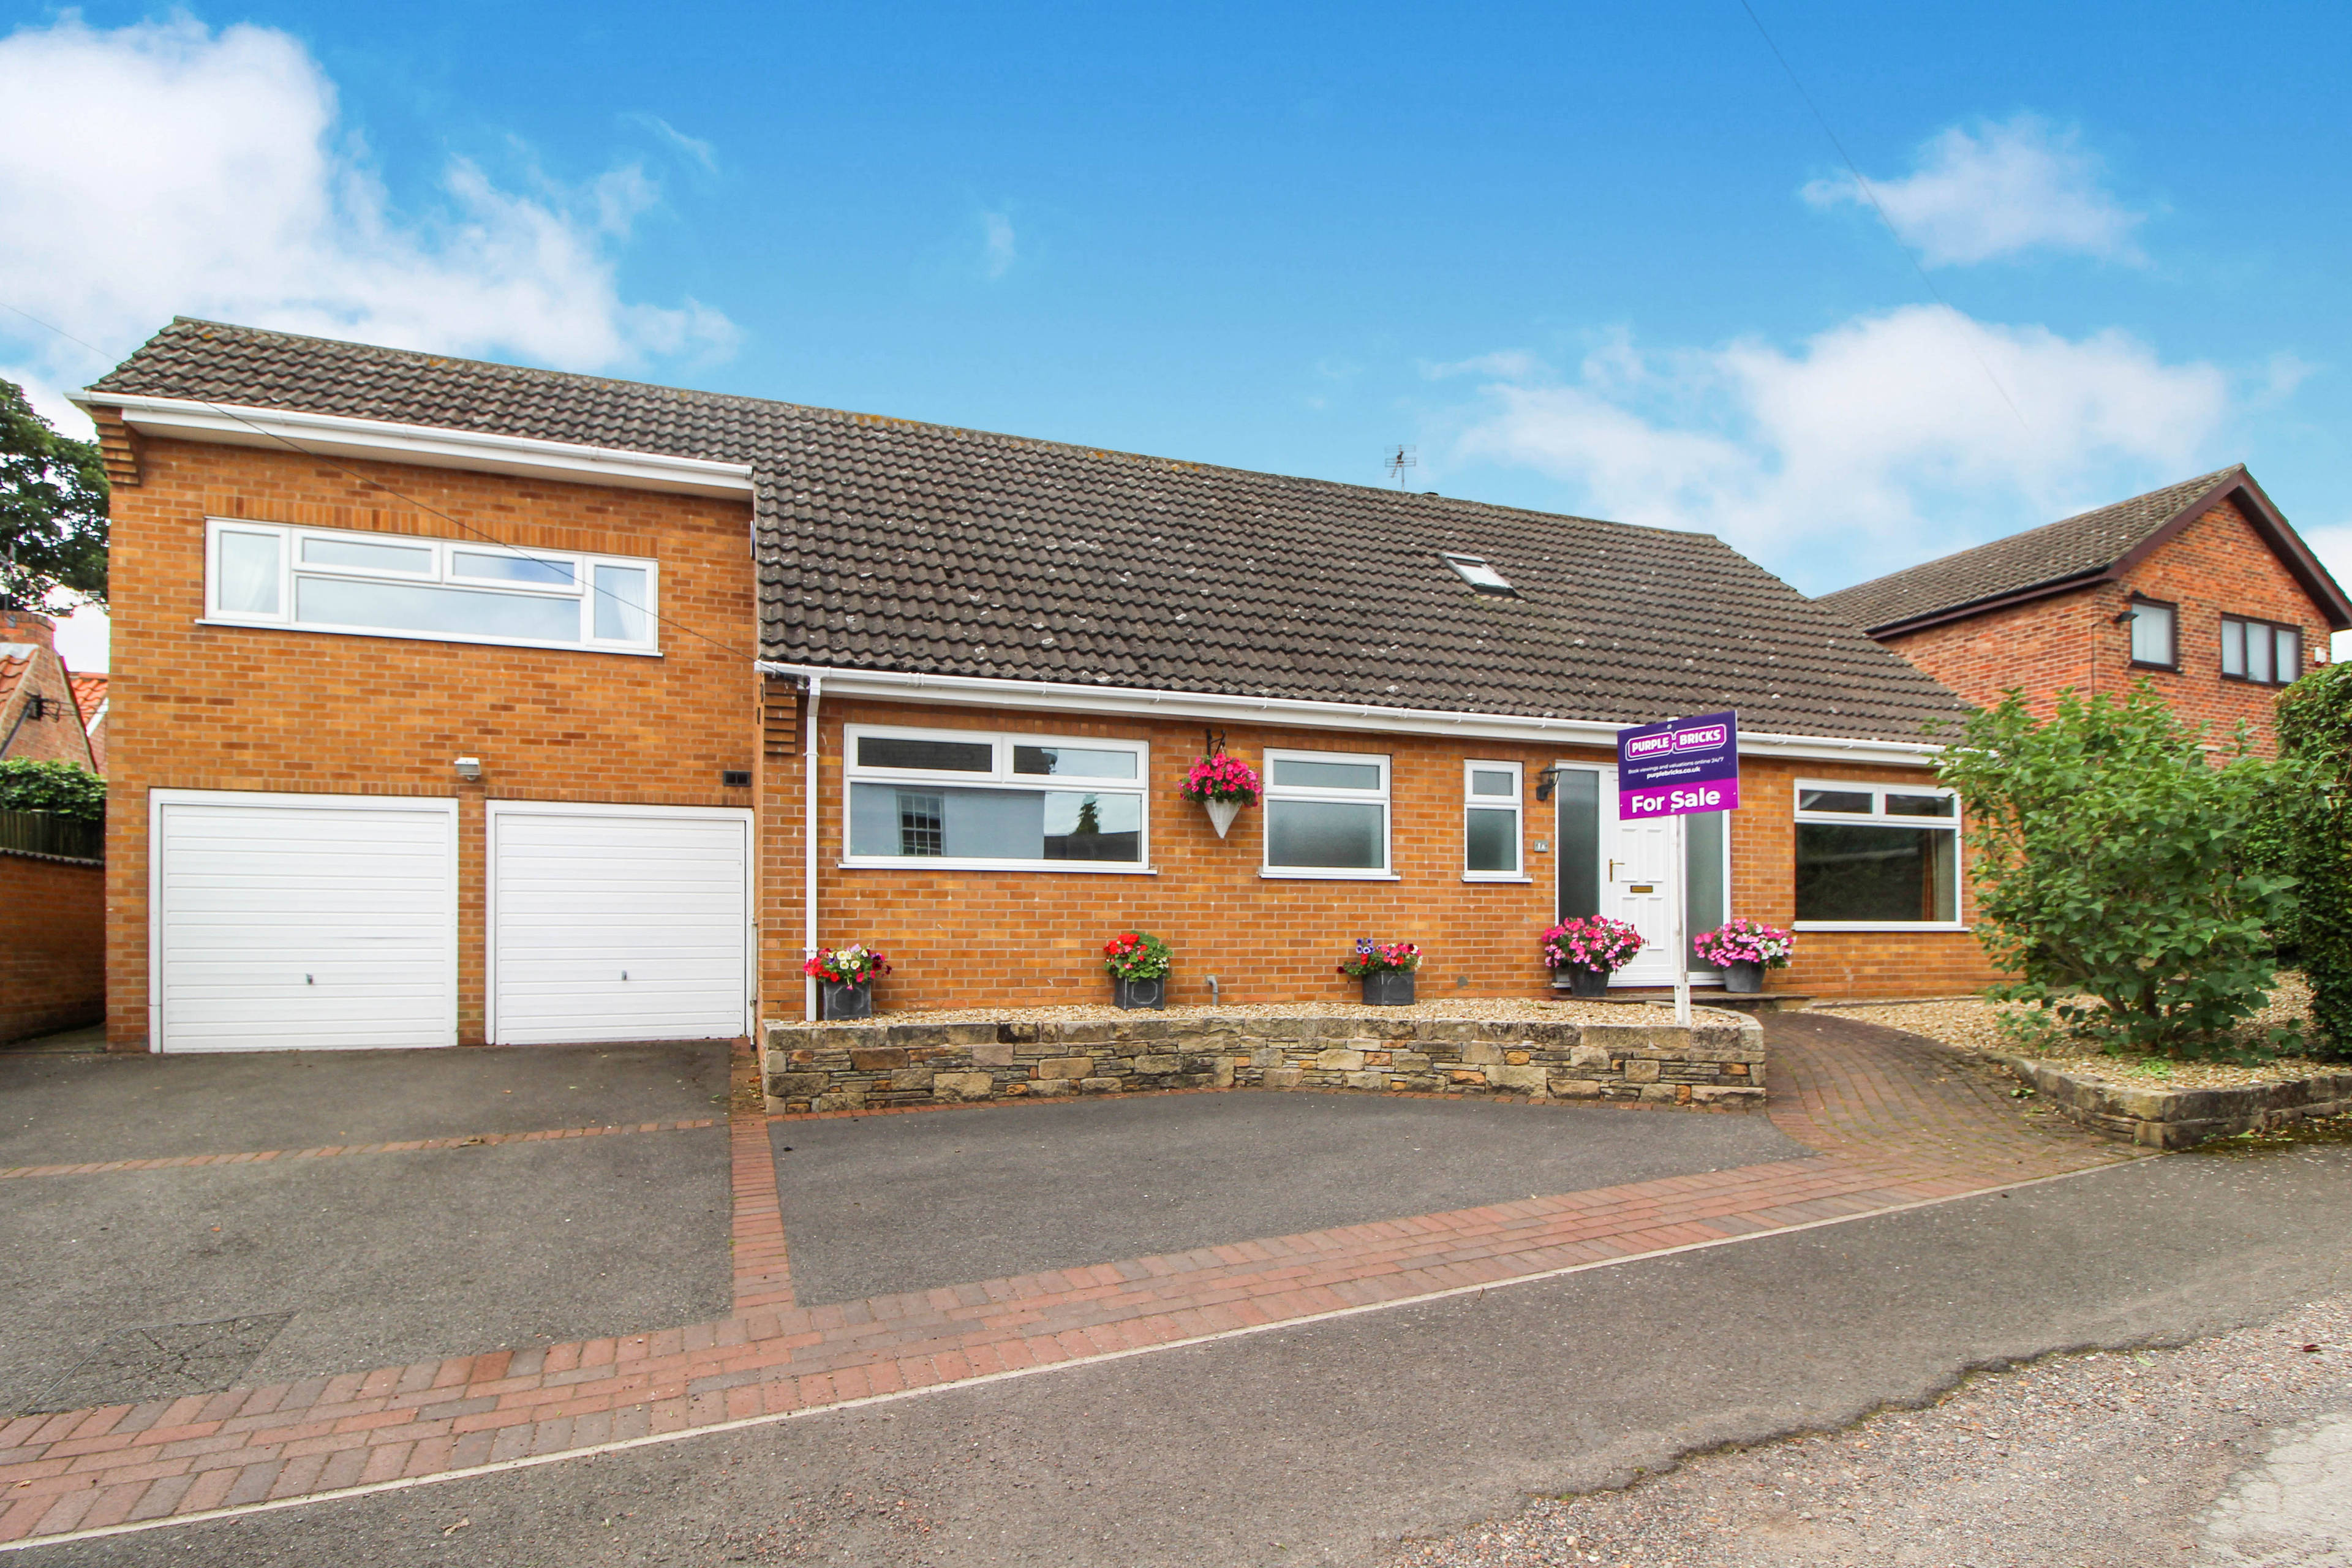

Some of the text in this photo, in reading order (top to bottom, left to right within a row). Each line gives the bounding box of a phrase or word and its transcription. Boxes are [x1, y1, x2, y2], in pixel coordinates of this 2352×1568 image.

[1632, 729, 1721, 753] PURPLE BRICKS
[1646, 766, 1701, 779] purplebricks.co.uk
[1632, 788, 1721, 813] For Sale
